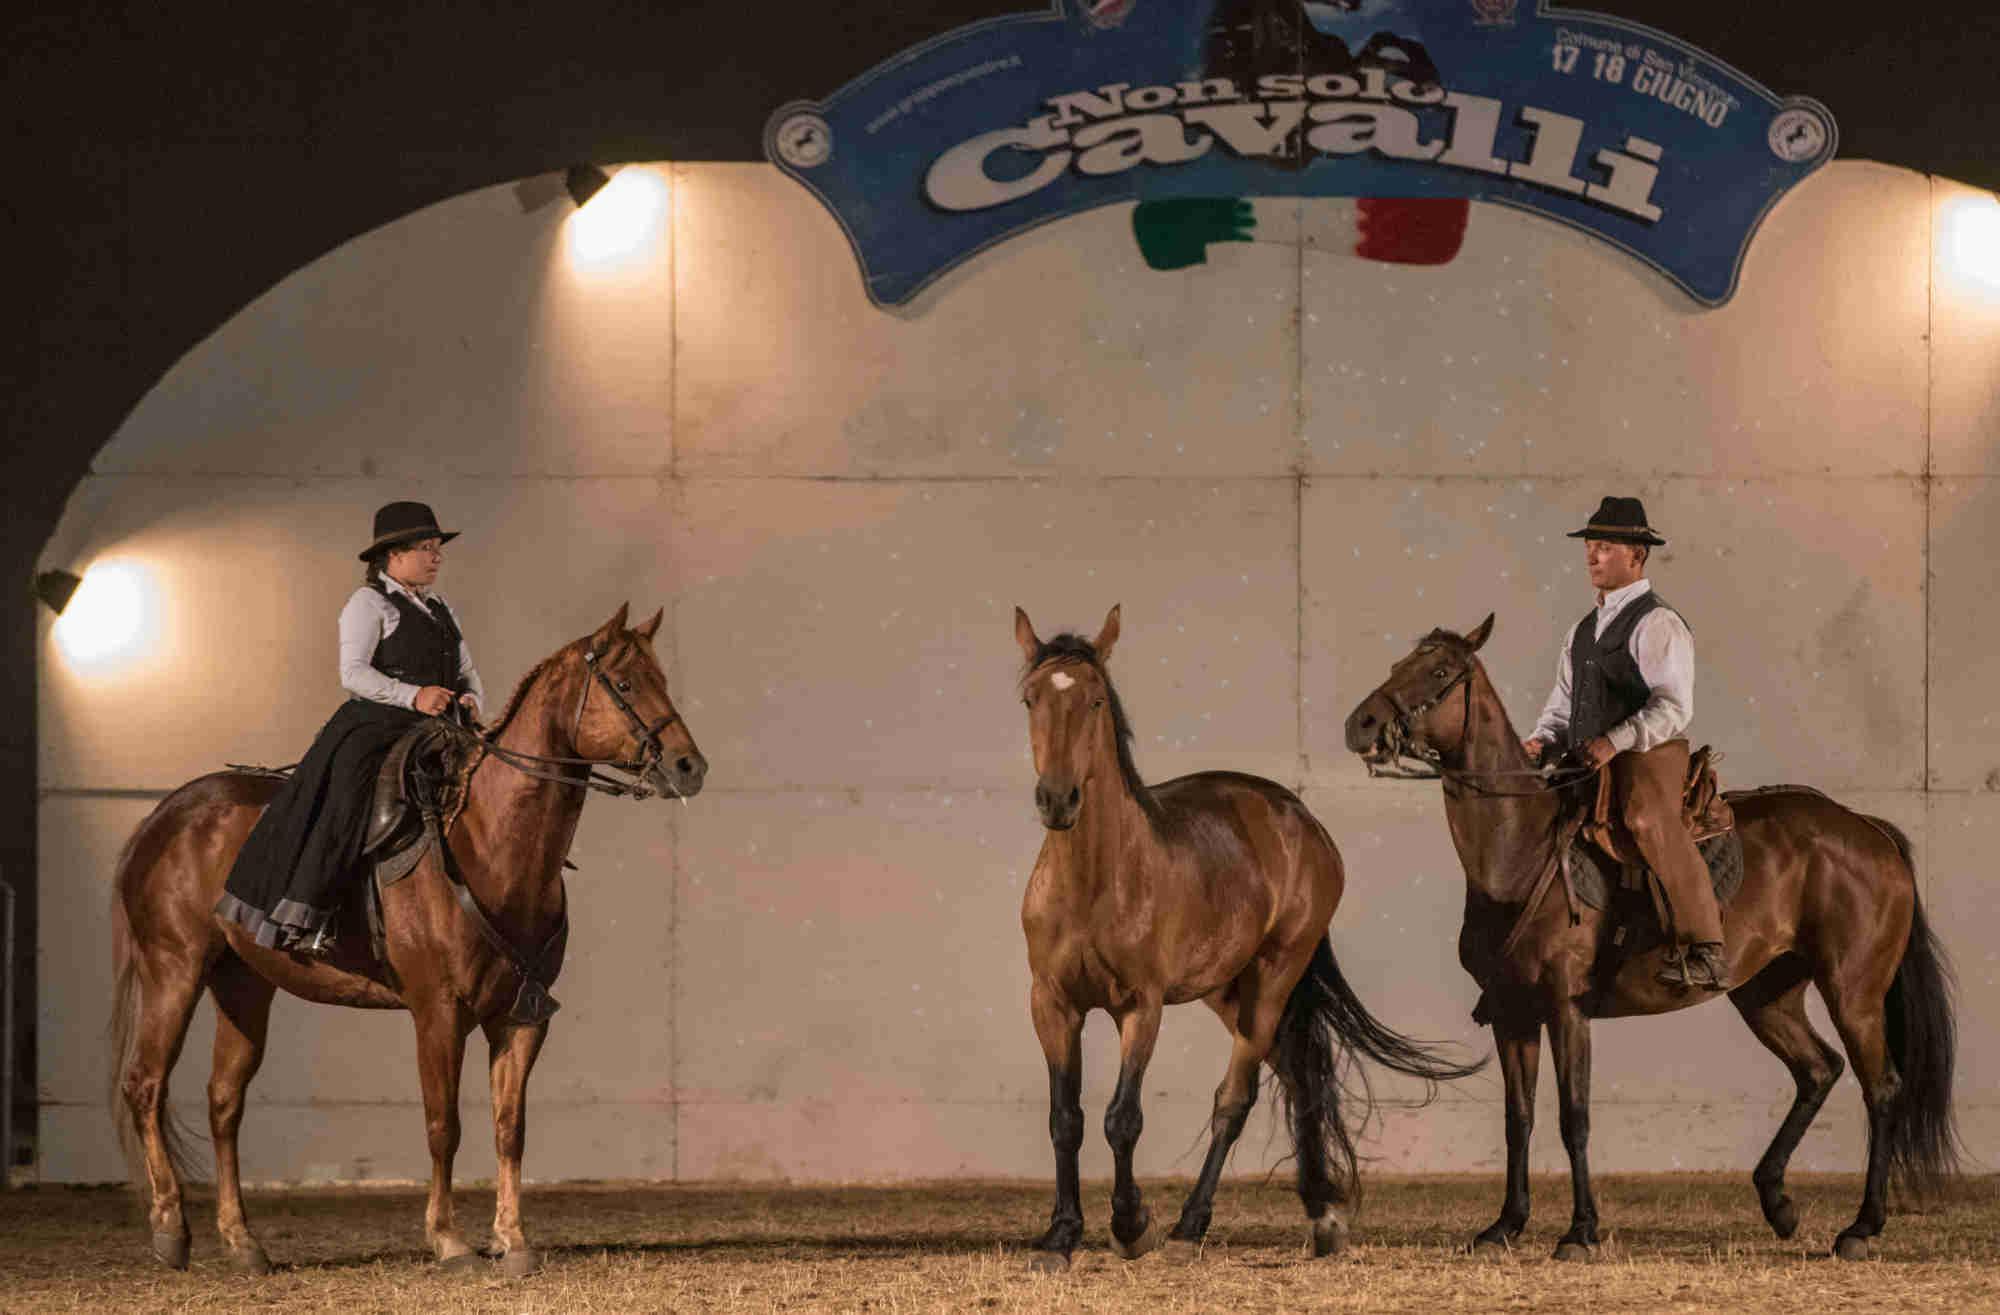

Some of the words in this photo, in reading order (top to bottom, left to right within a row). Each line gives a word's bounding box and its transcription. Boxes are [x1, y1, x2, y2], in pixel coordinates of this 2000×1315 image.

[1048, 78, 1240, 129] Non
[1257, 69, 1443, 105] solo
[1552, 44, 1580, 73] 17
[1594, 54, 1625, 82] 18
[1633, 64, 1729, 128] GIUGNO
[926, 91, 1662, 222] Cavalli
